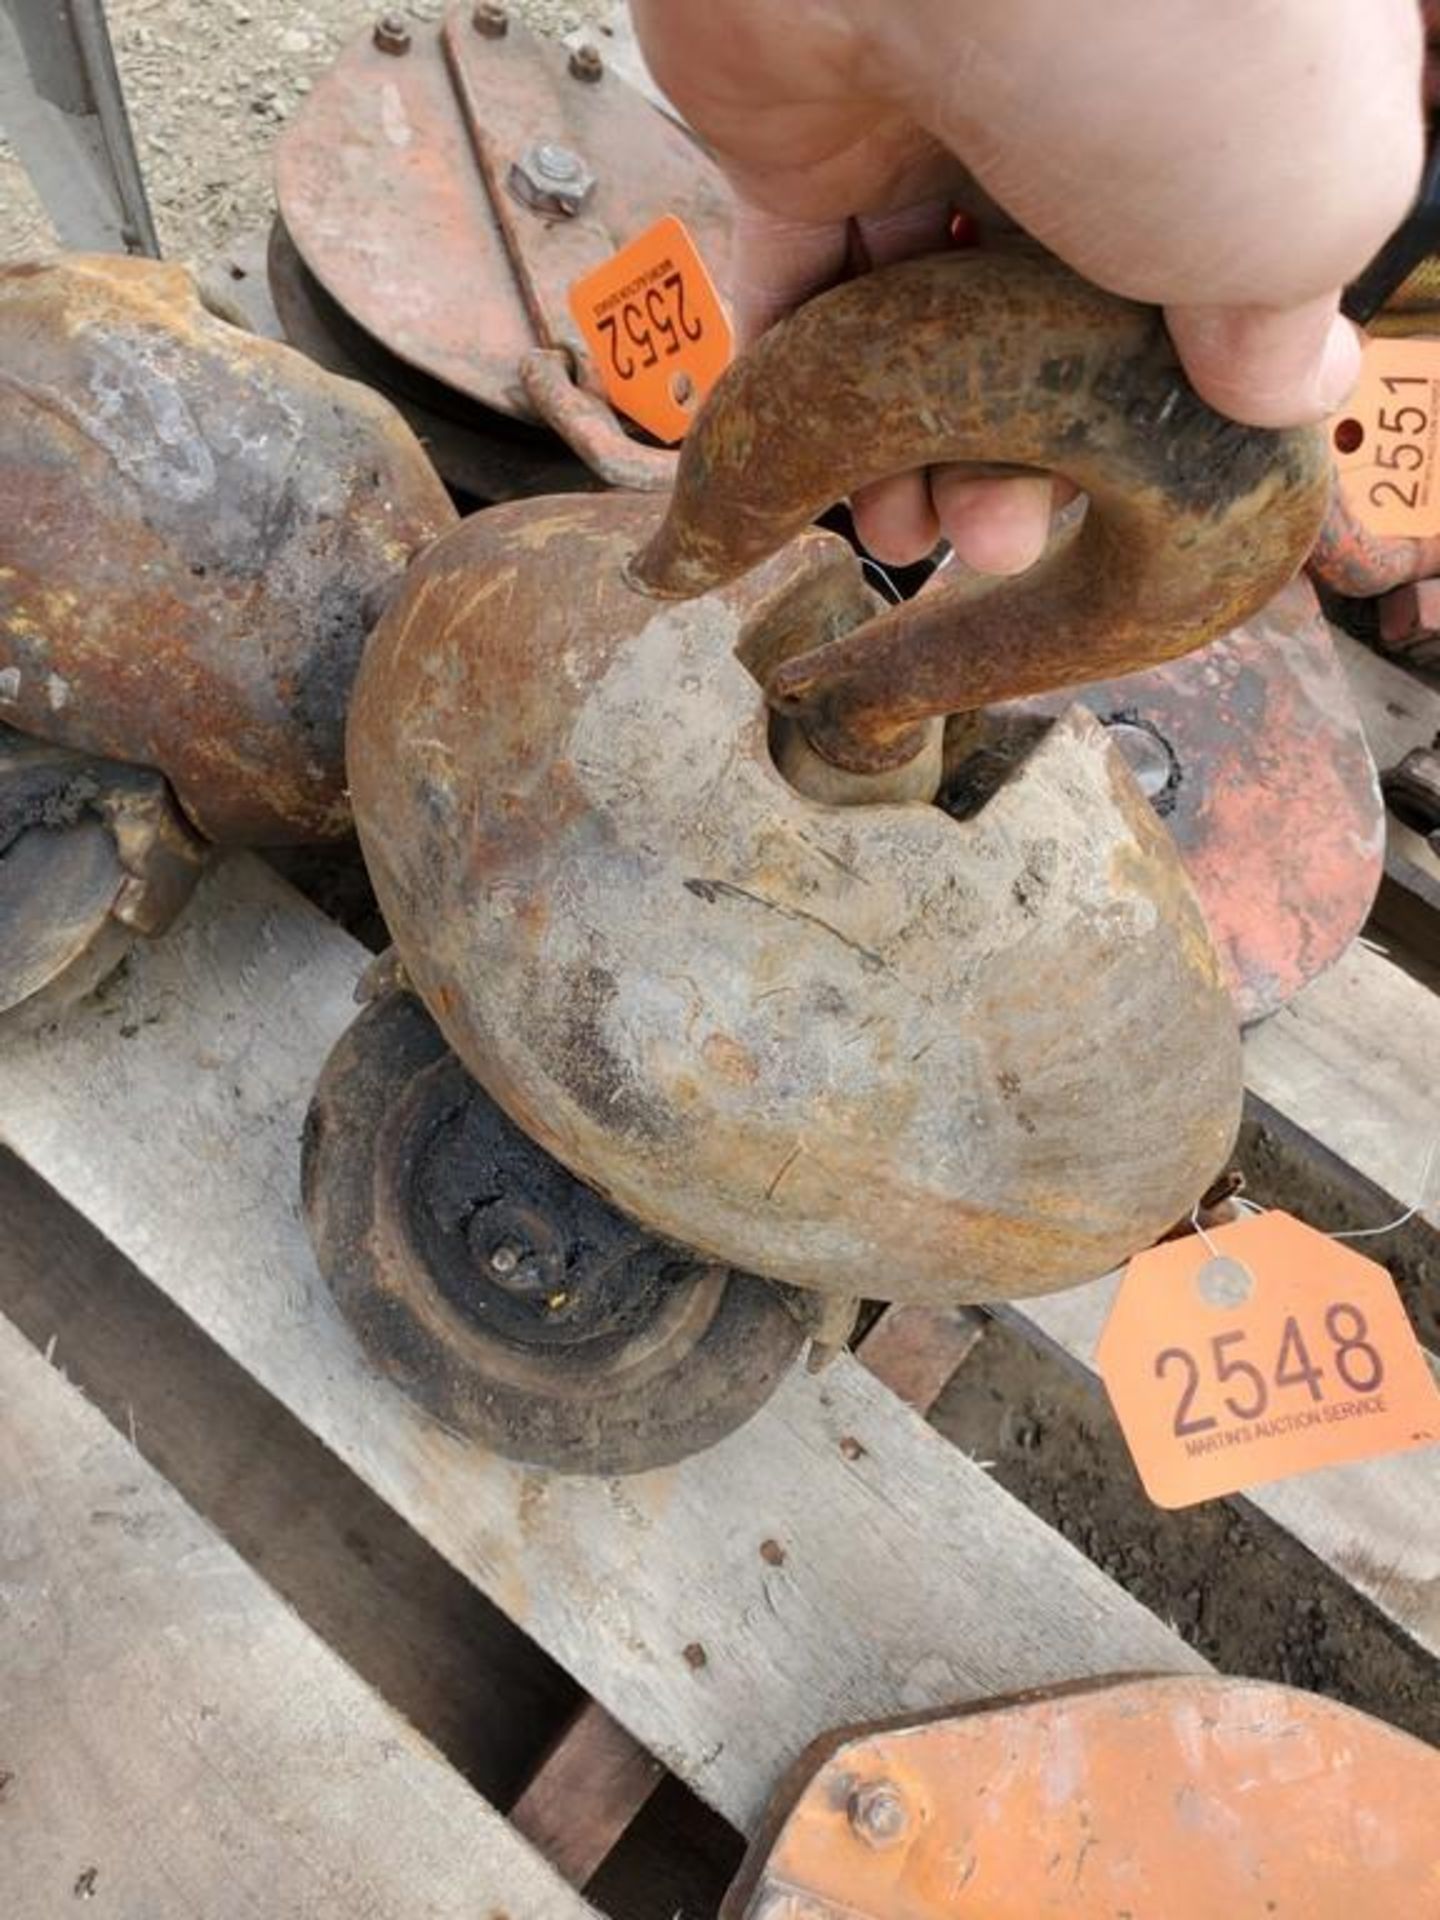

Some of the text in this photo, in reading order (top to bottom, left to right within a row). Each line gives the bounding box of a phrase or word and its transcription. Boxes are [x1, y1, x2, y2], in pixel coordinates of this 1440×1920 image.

[596, 271, 702, 380] 2552
[1369, 377, 1428, 508] 2551
[1155, 1303, 1384, 1437] 2548
[1256, 1413, 1322, 1438] AUCTION
[1324, 1397, 1388, 1423] SERVICE
